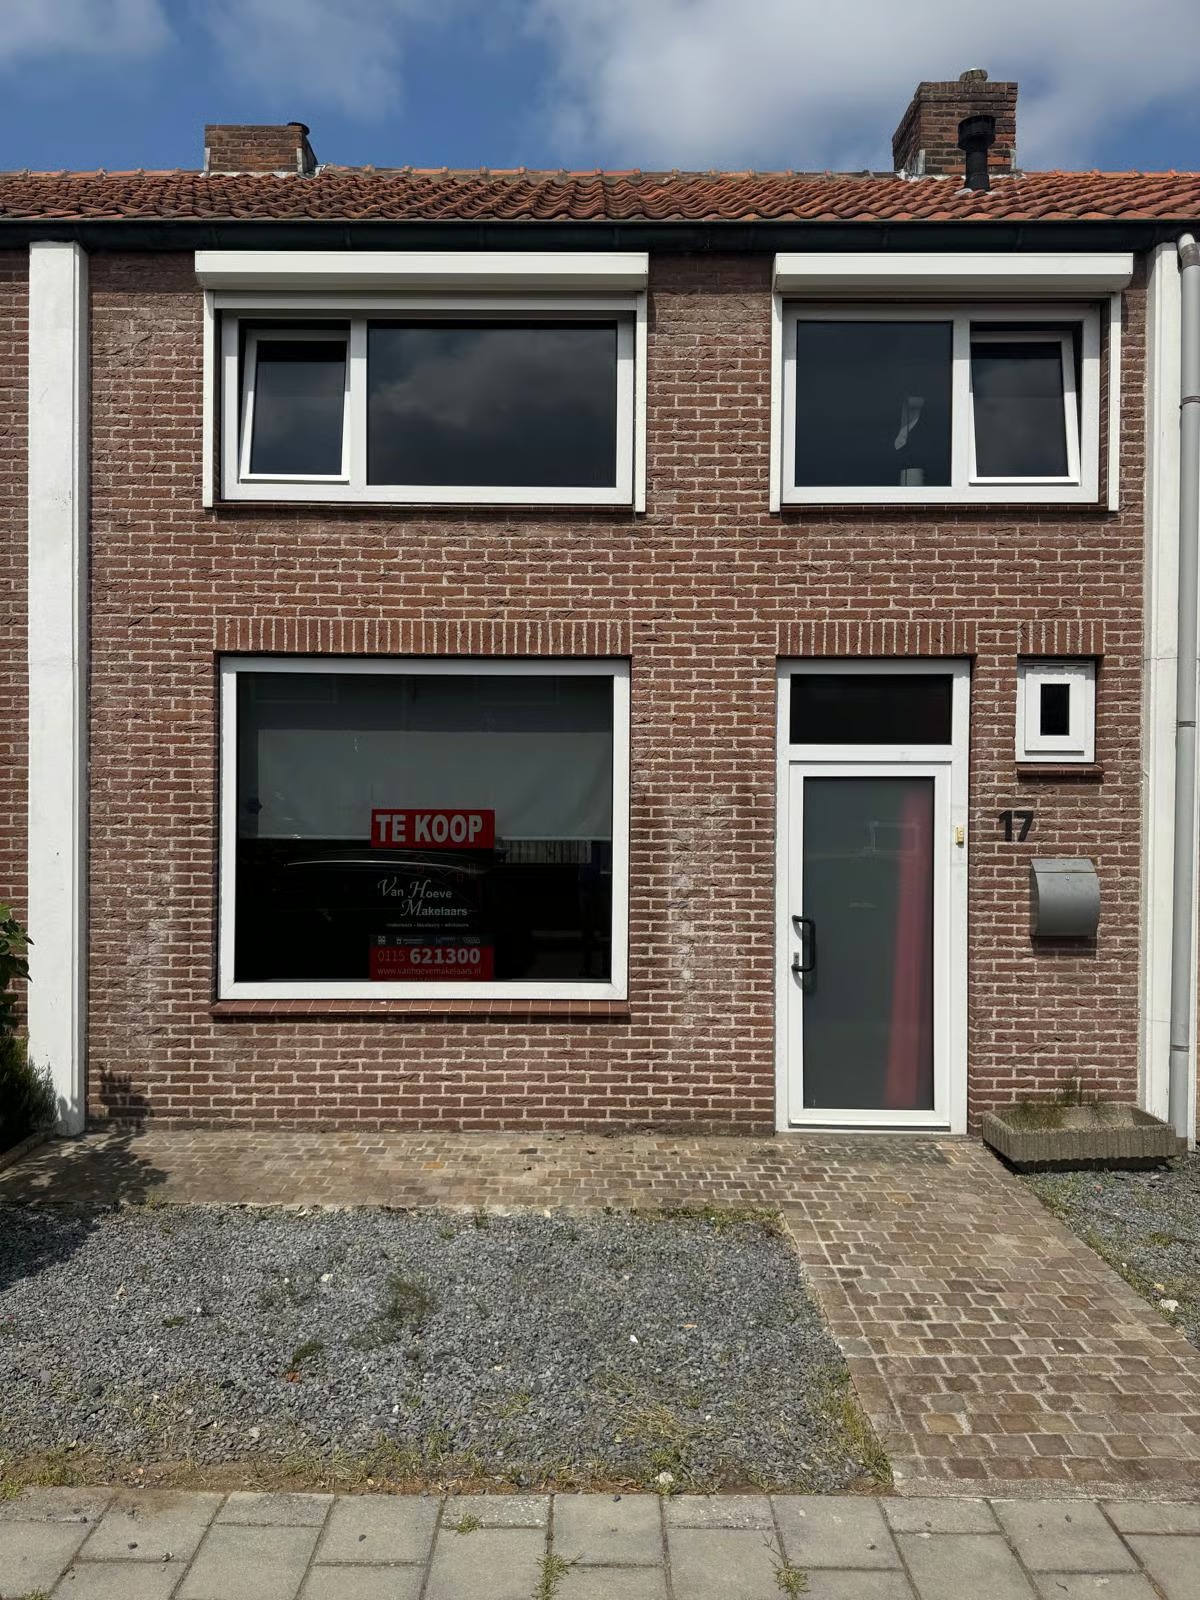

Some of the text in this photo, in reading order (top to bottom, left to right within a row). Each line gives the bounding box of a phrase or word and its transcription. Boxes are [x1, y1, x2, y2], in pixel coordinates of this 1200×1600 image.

[375, 814, 483, 843] TE KOOP
[999, 810, 1034, 842] 17
[377, 876, 453, 899] Van Hoeve
[400, 899, 468, 917] Makelaars
[409, 948, 481, 964] 621300
